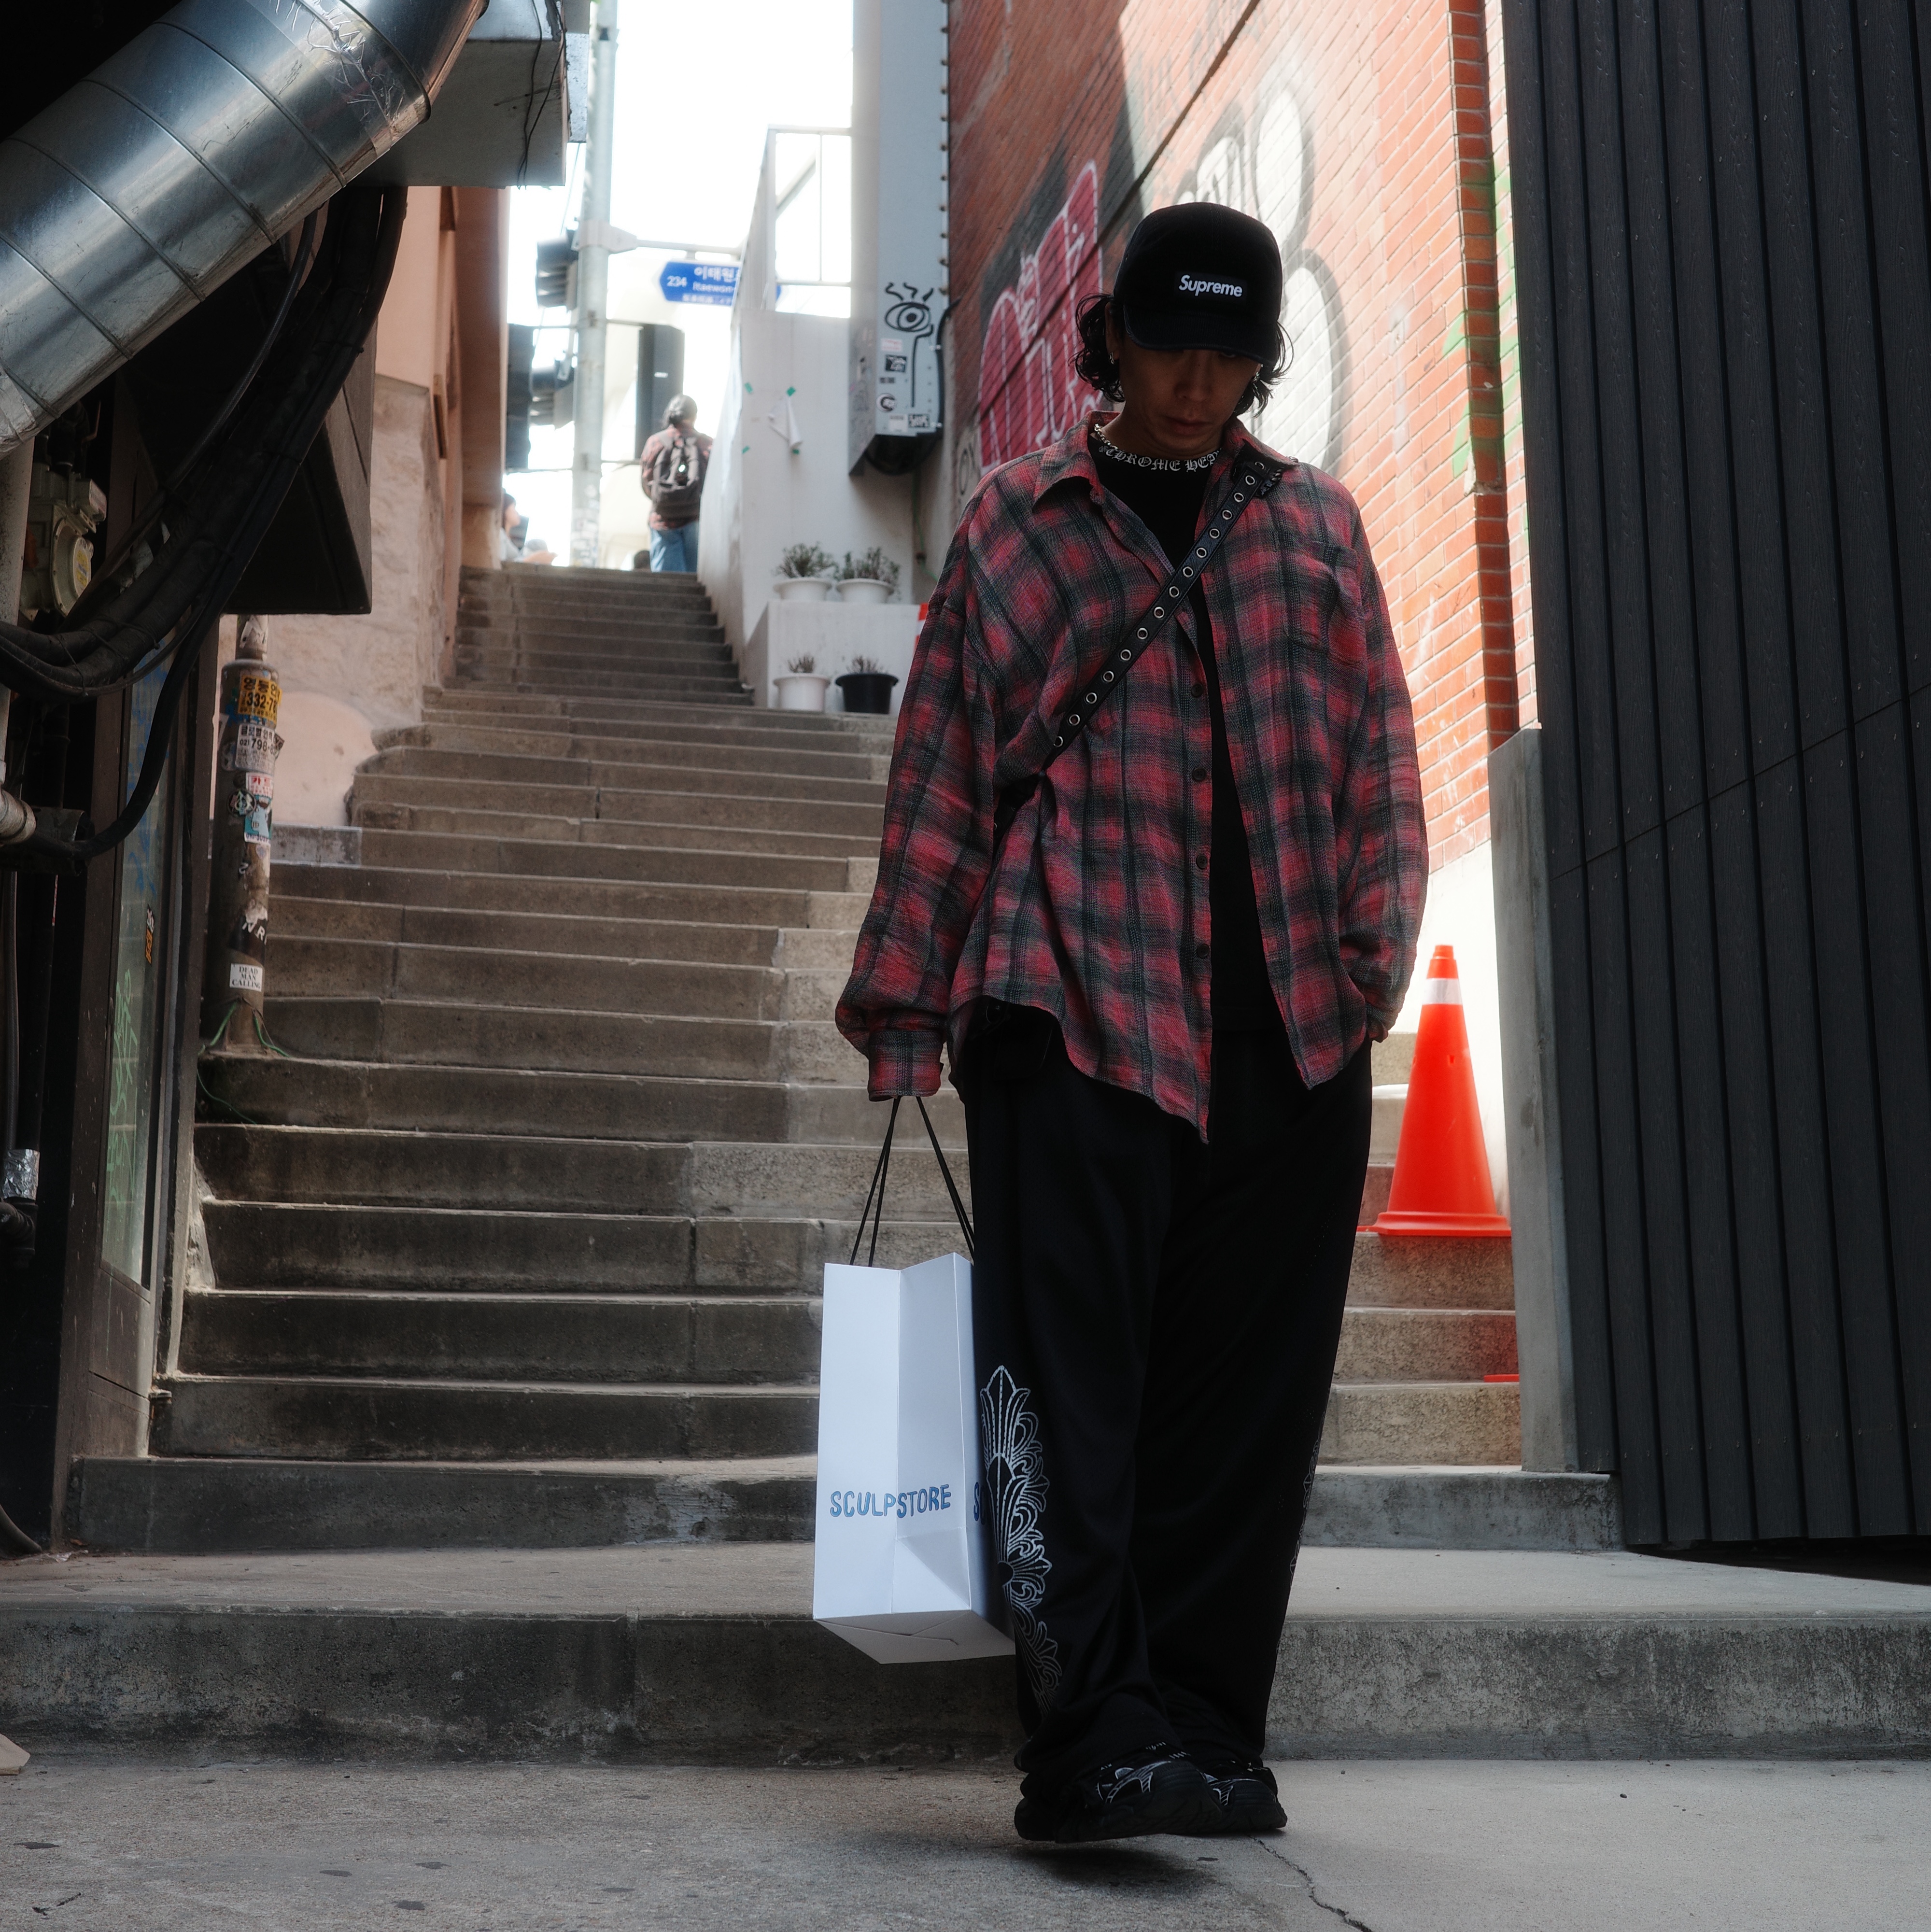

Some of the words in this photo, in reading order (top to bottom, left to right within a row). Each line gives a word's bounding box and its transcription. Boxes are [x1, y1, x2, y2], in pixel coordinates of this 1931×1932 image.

[667, 275, 687, 287] 234
[1179, 274, 1242, 296] Supreme
[1105, 448, 1181, 471] CHROME
[239, 966, 258, 974] DEAD
[240, 973, 256, 981] MAN
[232, 979, 261, 989] CALLING
